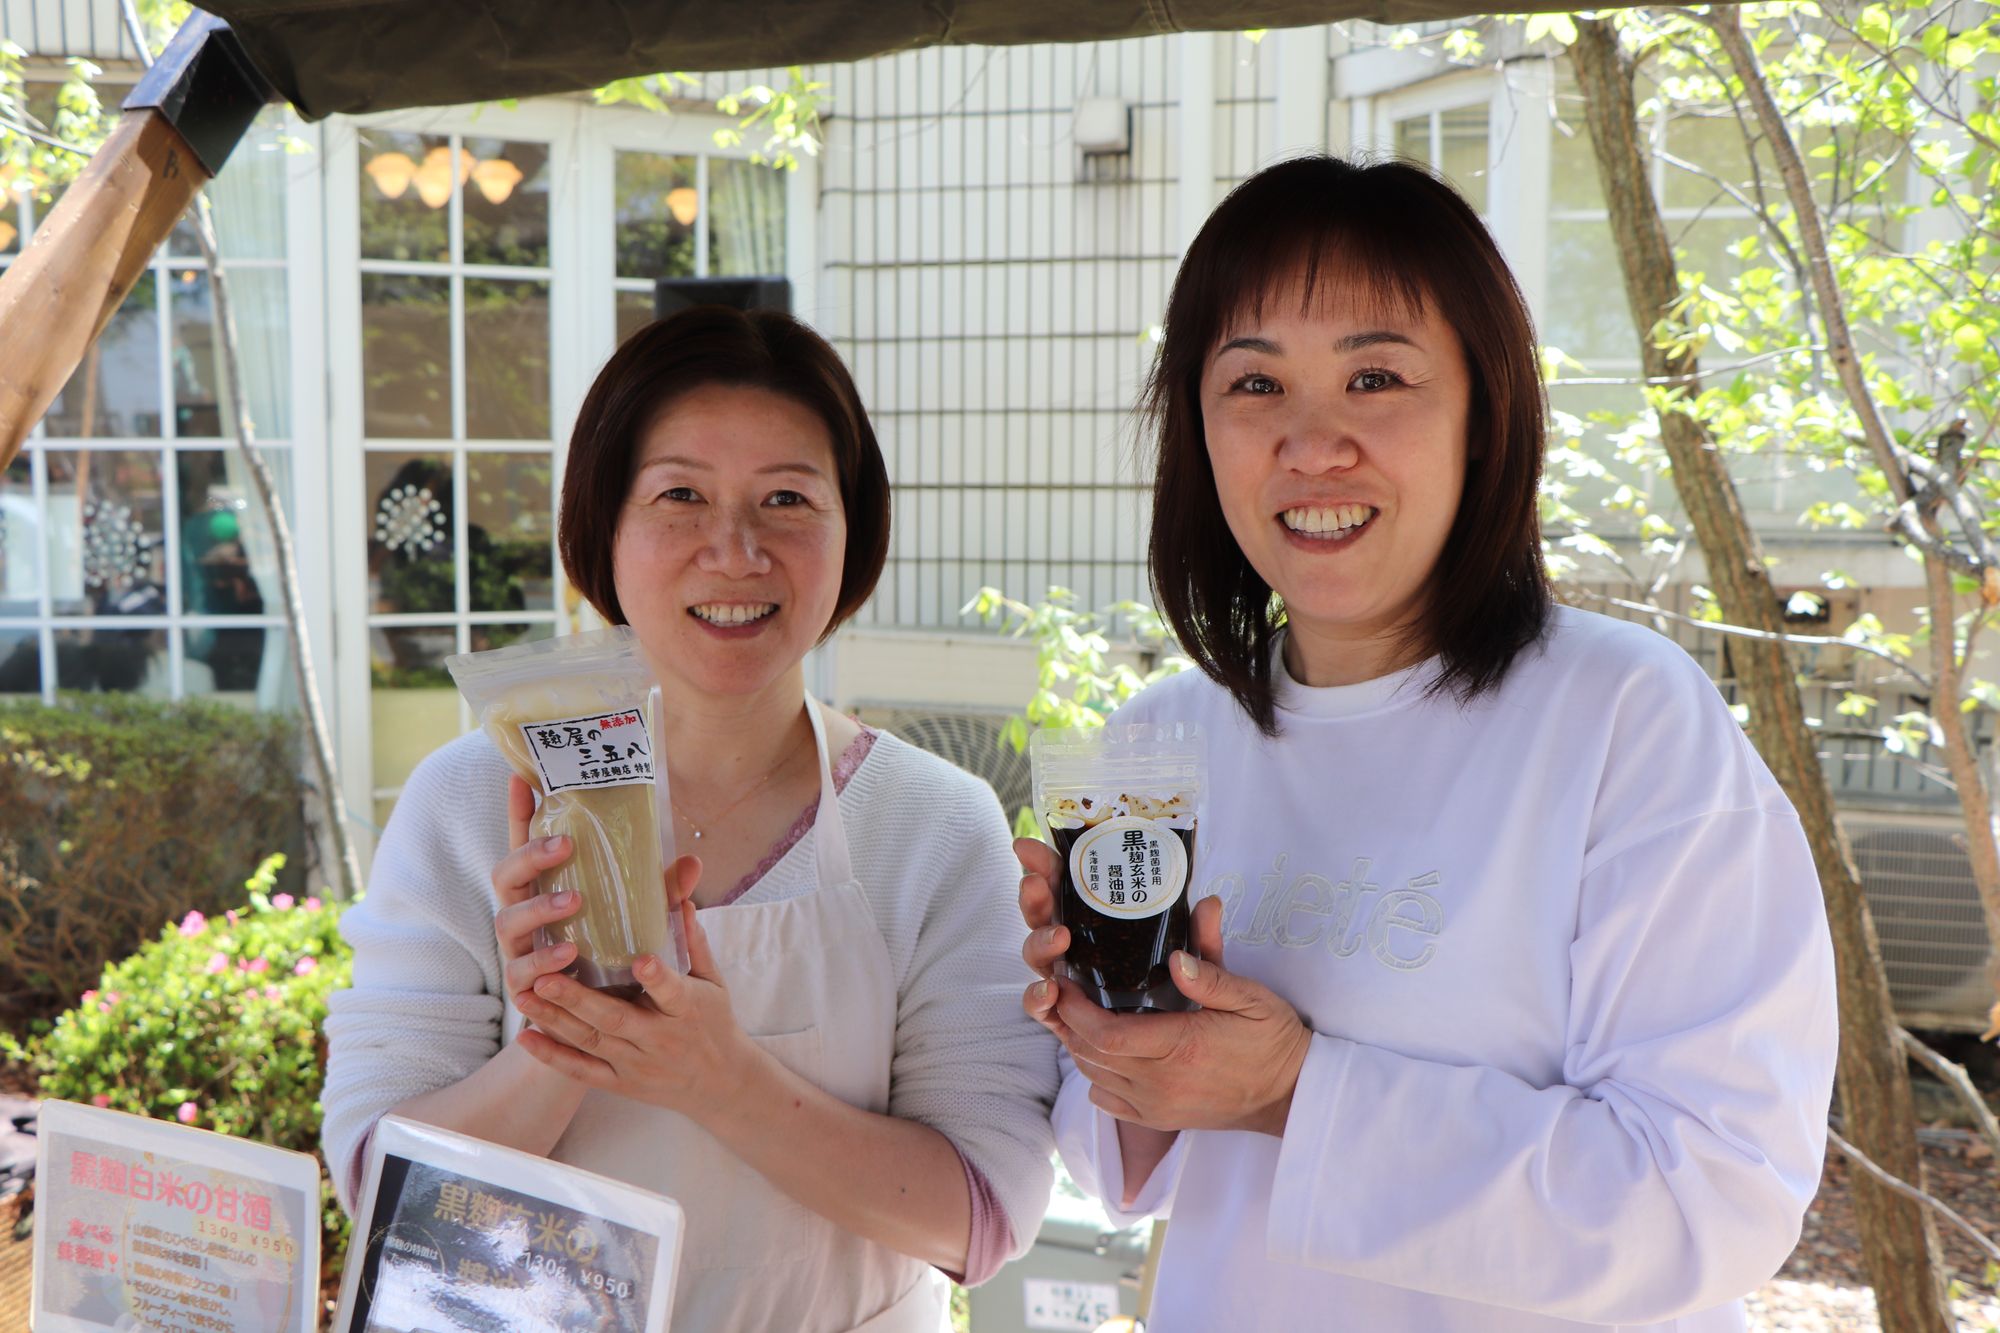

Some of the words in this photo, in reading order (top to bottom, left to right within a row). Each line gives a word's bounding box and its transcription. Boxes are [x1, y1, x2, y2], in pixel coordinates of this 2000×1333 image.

[600, 715, 637, 730] 無添加
[579, 742, 647, 766] 三五八
[1121, 829, 1148, 904] 黒麹玄米の
[198, 1220, 239, 1244] 130g
[580, 1267, 630, 1299] ¥950
